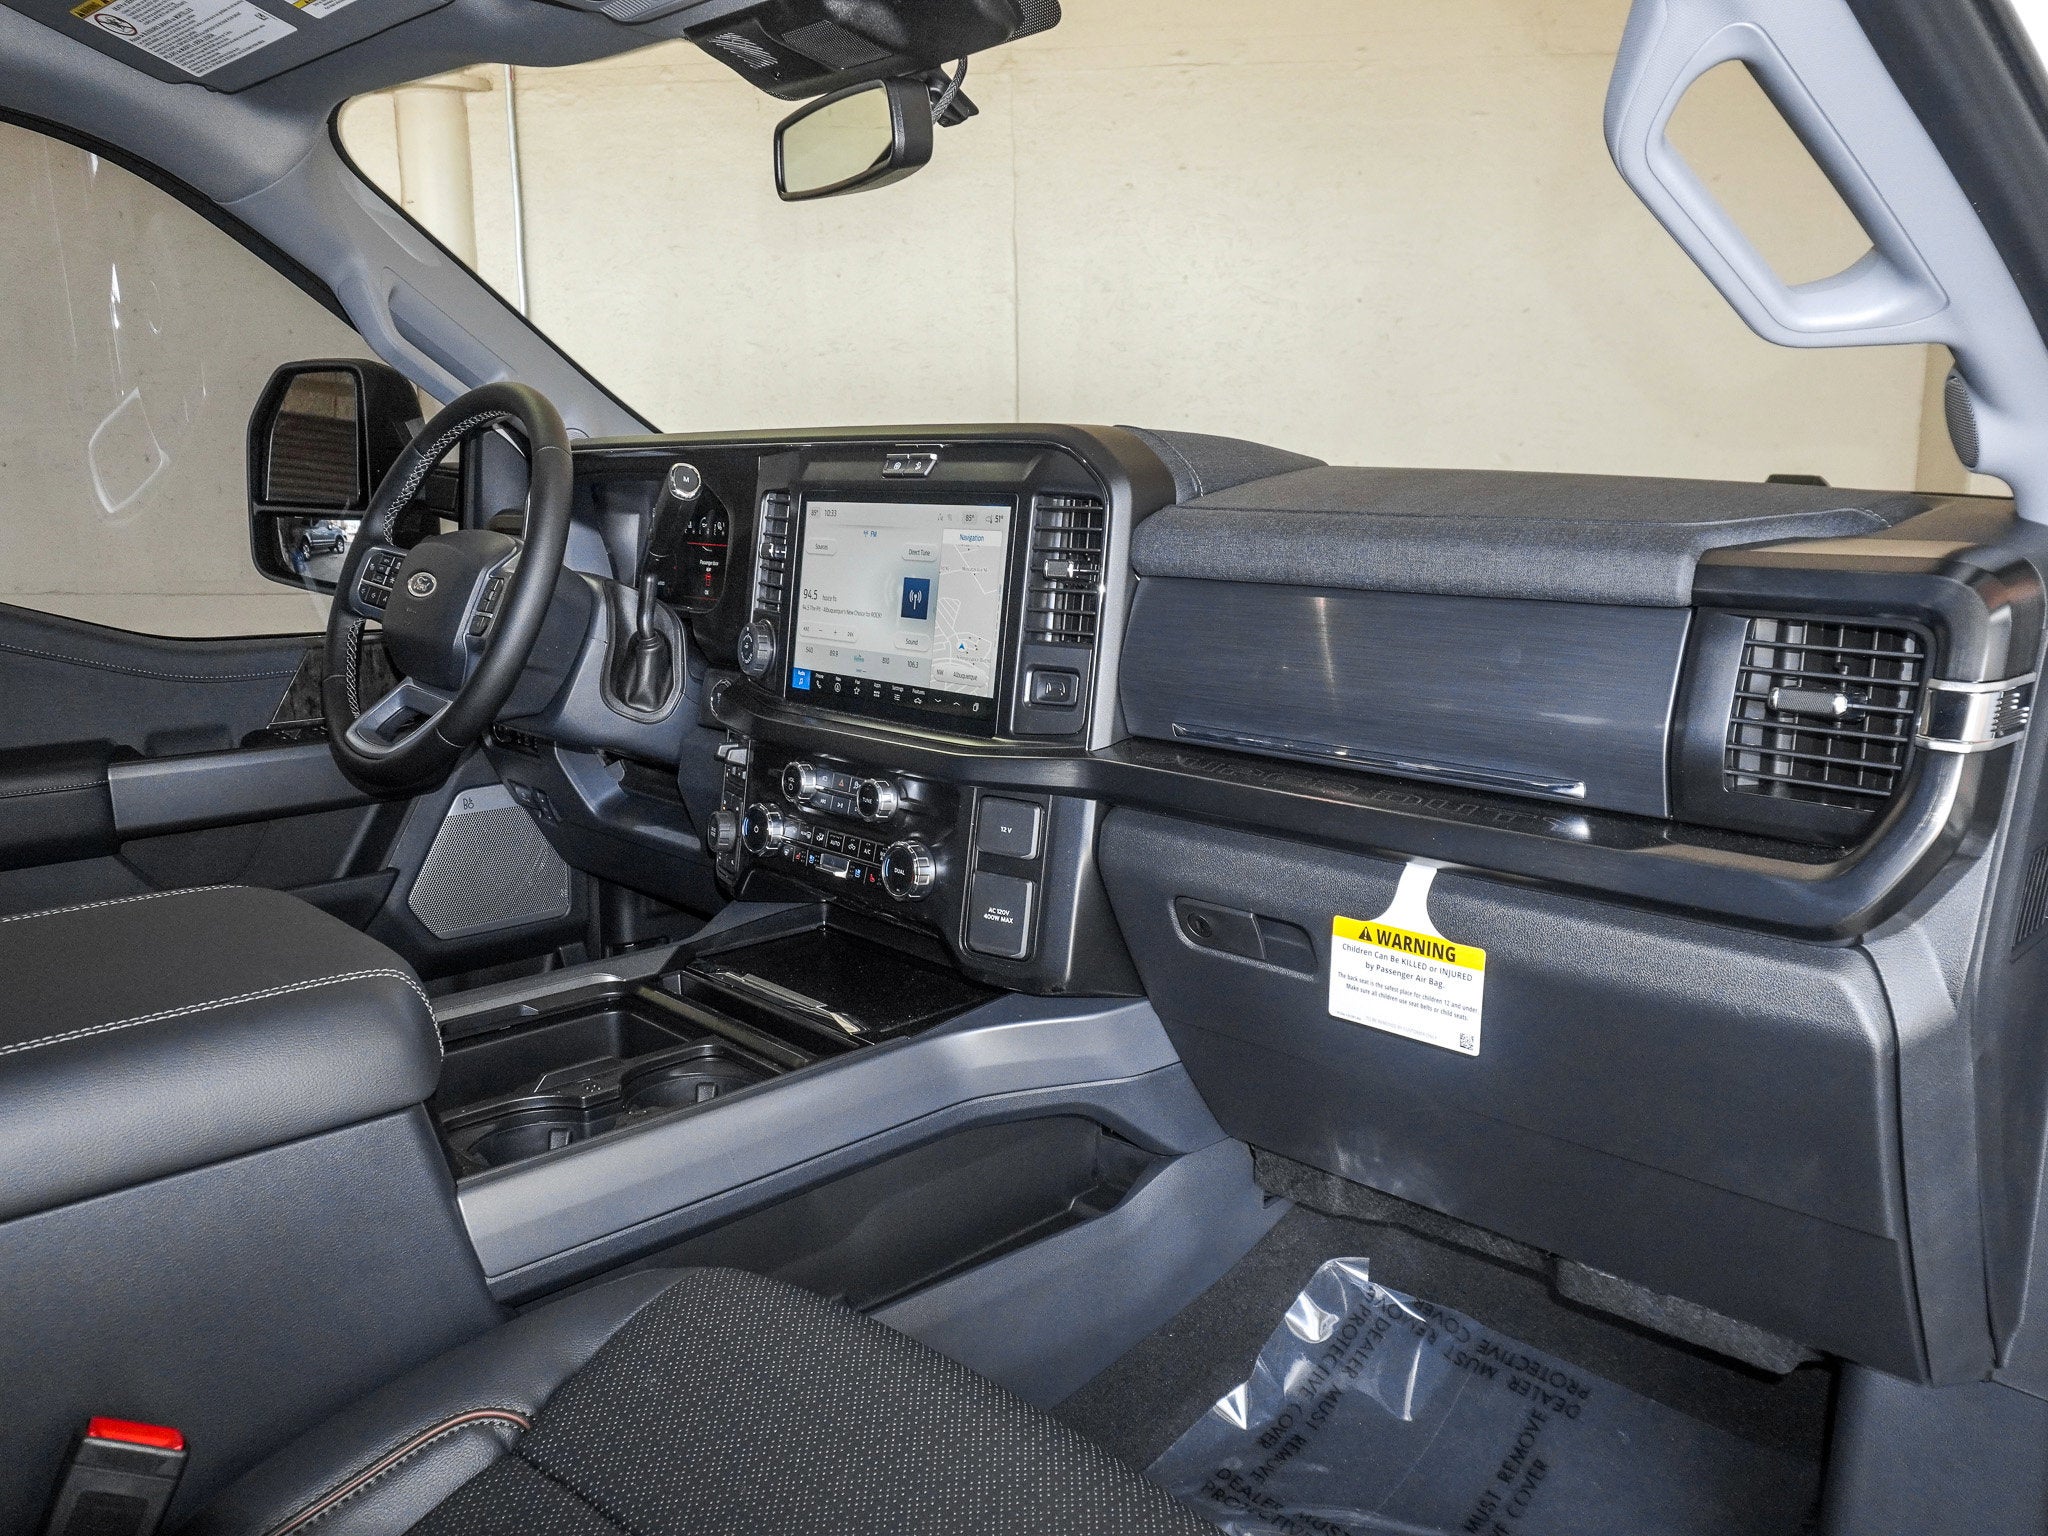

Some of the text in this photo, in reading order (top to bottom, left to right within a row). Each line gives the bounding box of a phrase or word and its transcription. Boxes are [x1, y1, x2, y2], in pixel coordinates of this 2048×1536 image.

[960, 534, 984, 542] Navigation
[803, 589, 818, 600] 94.5
[984, 914, 1013, 924] 400W MAX
[1376, 928, 1456, 962] WARNING
[1342, 943, 1473, 982] Children Can Be KILLED or INJURED
[1365, 962, 1445, 989] by Passenger Air Bag.
[1378, 993, 1398, 1001] children
[1420, 1003, 1432, 1011] belts
[1422, 995, 1442, 1004] children
[1341, 1316, 1391, 1379] DEALER
[1443, 1345, 1499, 1379] MUST
[1475, 1339, 1591, 1399] PROTECTIVE
[1508, 1375, 1581, 1420] DEALER
[1497, 1407, 1547, 1485] REMOVE
[1507, 1457, 1548, 1518] COVER
